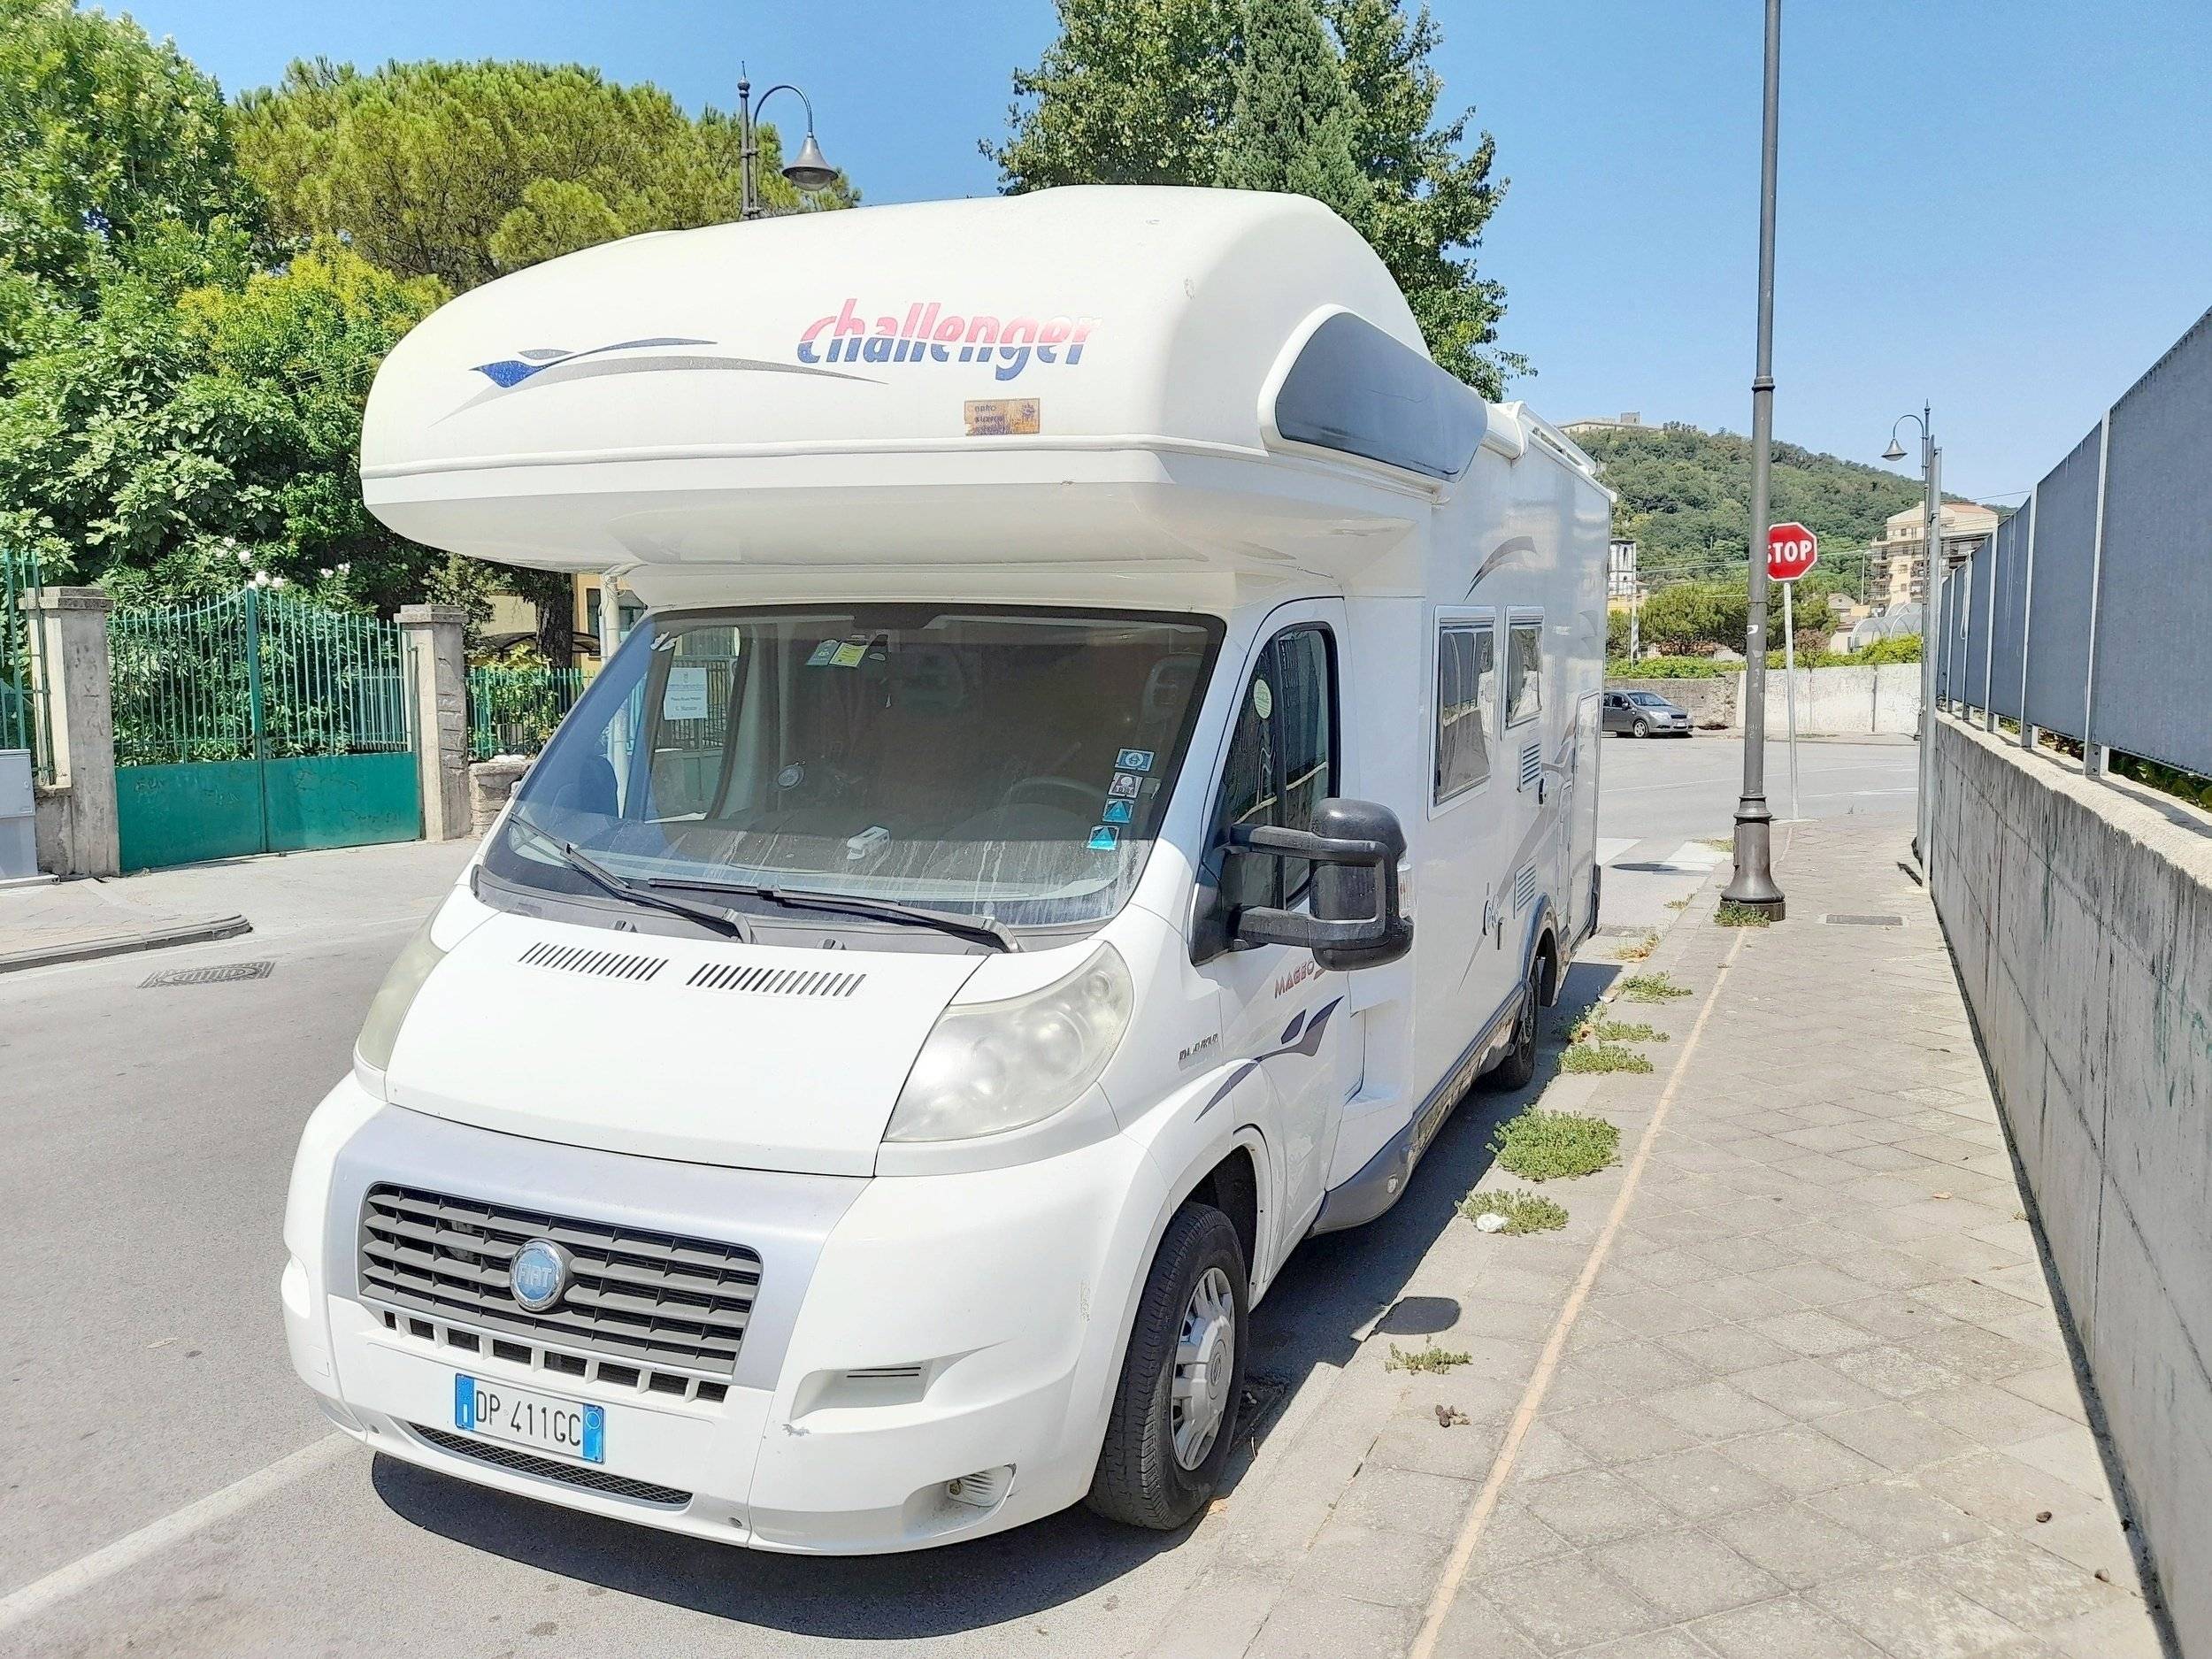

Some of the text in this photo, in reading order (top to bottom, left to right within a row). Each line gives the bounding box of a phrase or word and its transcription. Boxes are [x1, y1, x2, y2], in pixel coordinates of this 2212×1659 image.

[797, 298, 1100, 381] challenger
[518, 1263, 552, 1287] FIAT
[476, 1390, 581, 1445] DP 411GC
